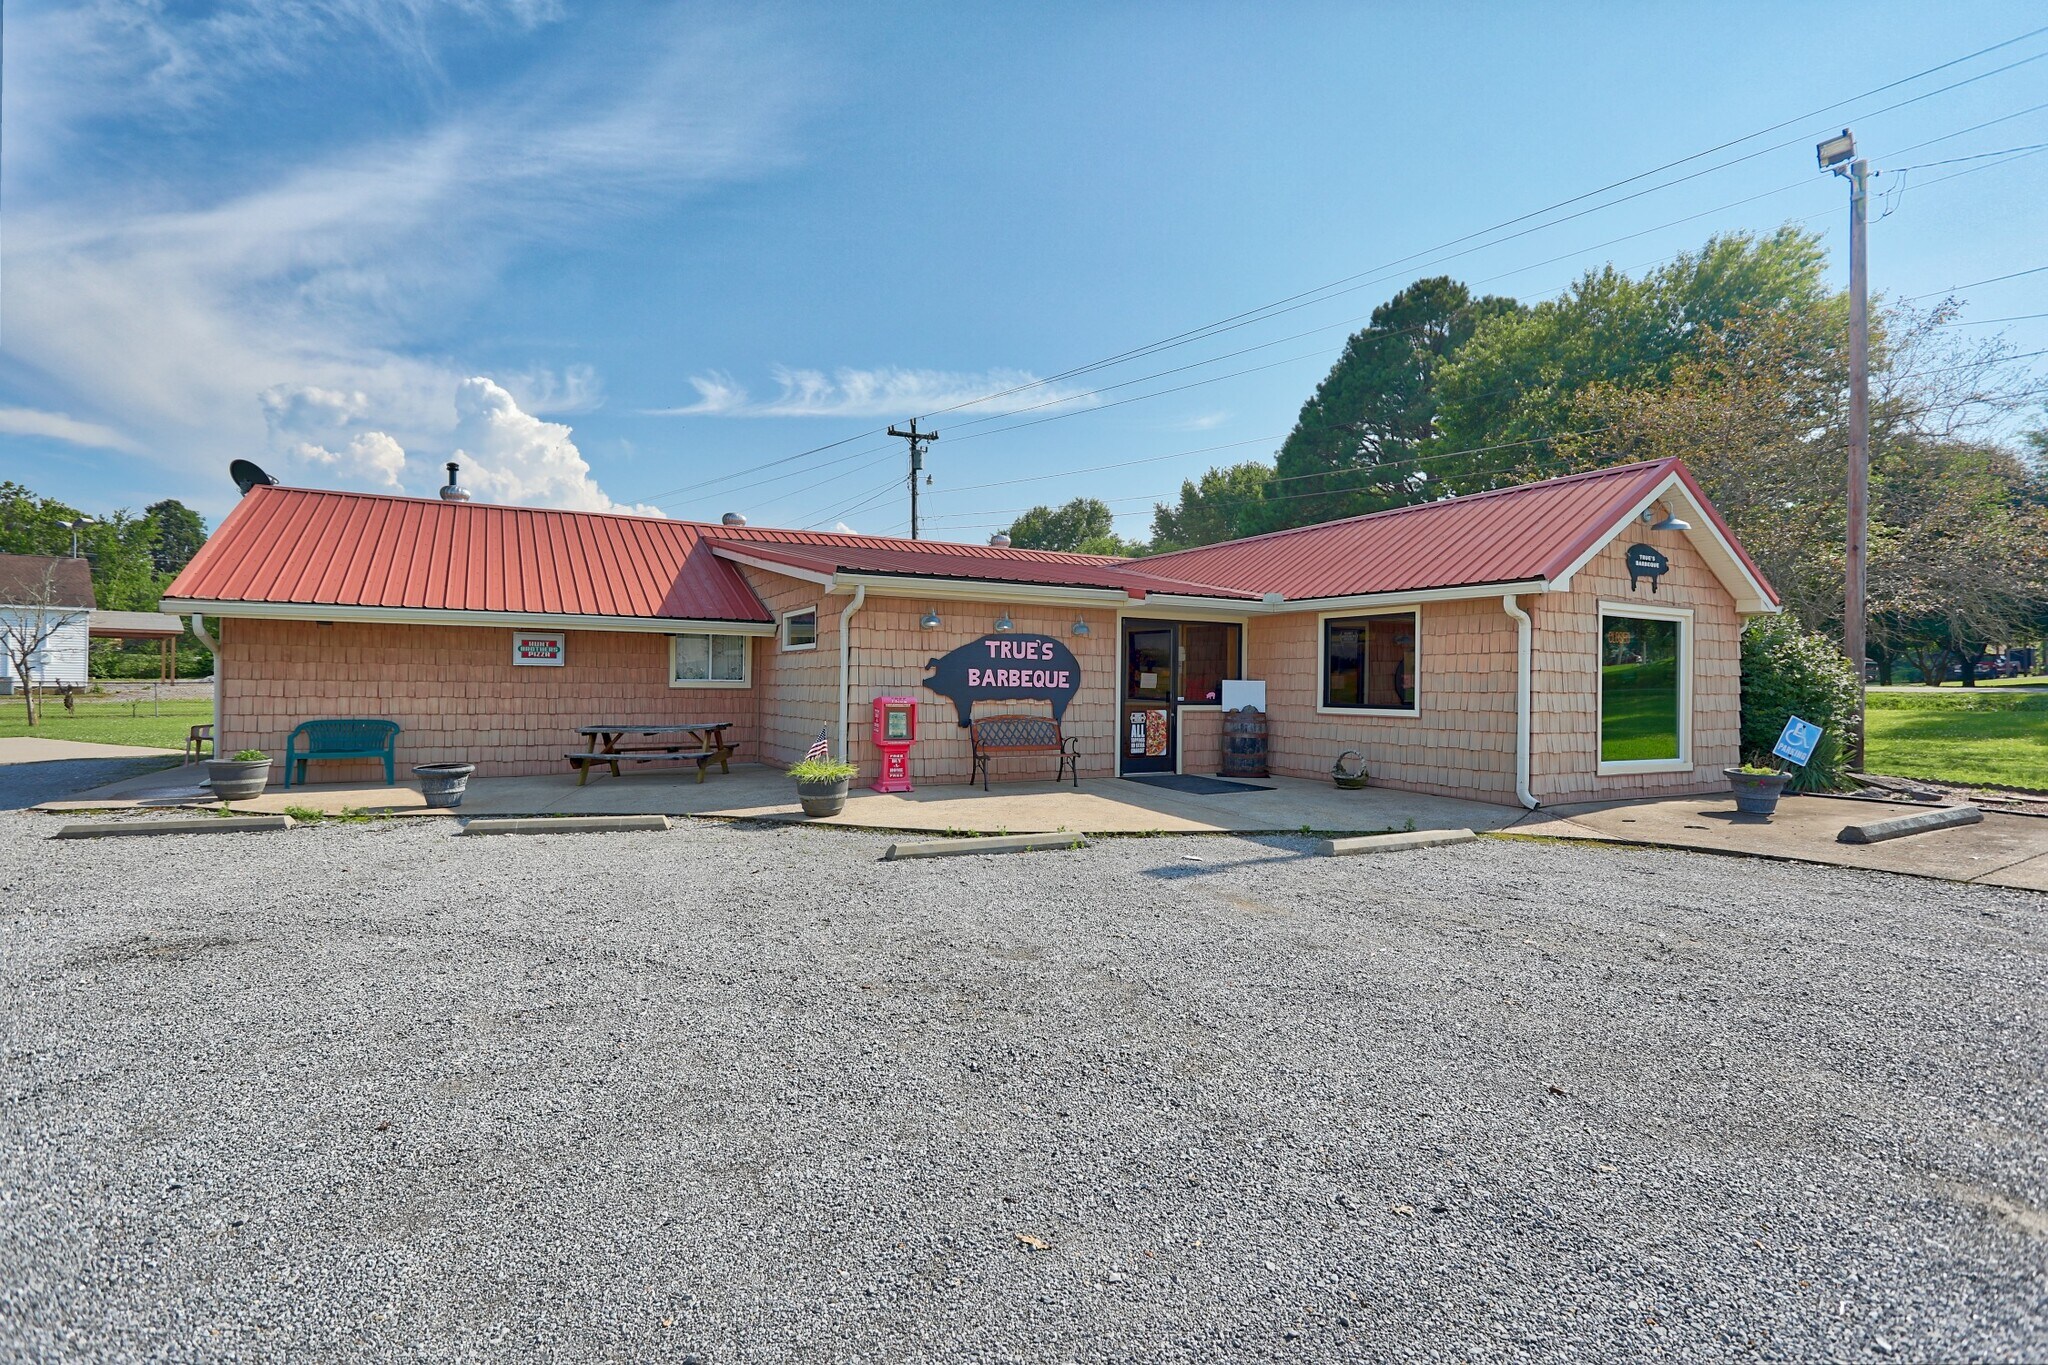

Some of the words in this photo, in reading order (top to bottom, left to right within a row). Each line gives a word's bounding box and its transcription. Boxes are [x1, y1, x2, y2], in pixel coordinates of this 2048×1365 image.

[1639, 554, 1656, 562] TRUE'S
[985, 639, 1054, 661] TRUE'S
[968, 669, 1070, 689] BARBEQUE
[1131, 724, 1145, 738] ALL
[1778, 743, 1807, 760] PARKING
